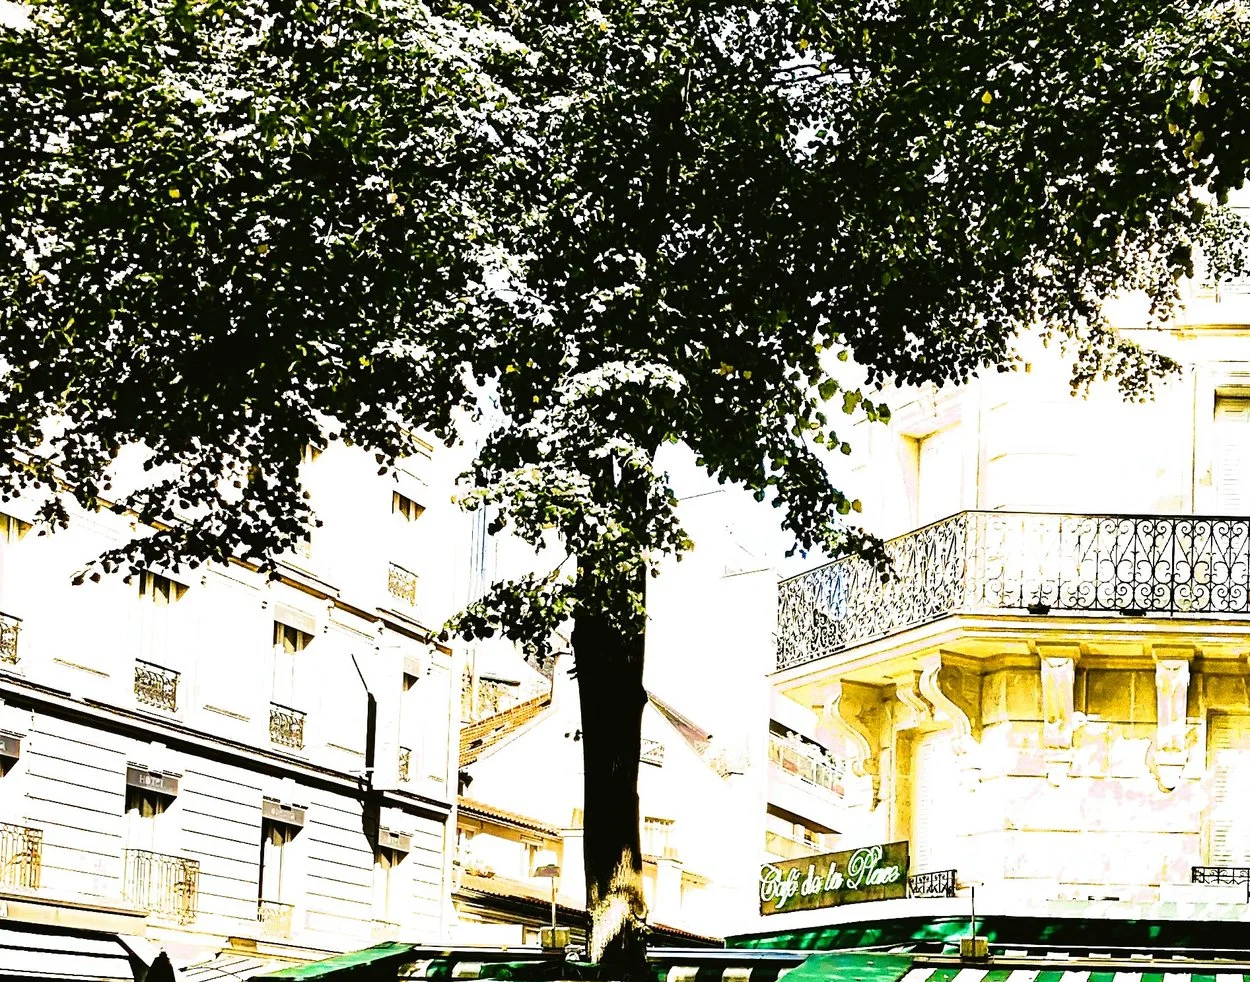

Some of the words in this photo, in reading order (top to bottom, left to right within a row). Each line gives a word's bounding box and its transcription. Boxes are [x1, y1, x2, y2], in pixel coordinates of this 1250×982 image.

[760, 863, 800, 908] Café
[801, 864, 824, 897] de
[824, 861, 843, 892] la
[847, 845, 900, 889] Place
